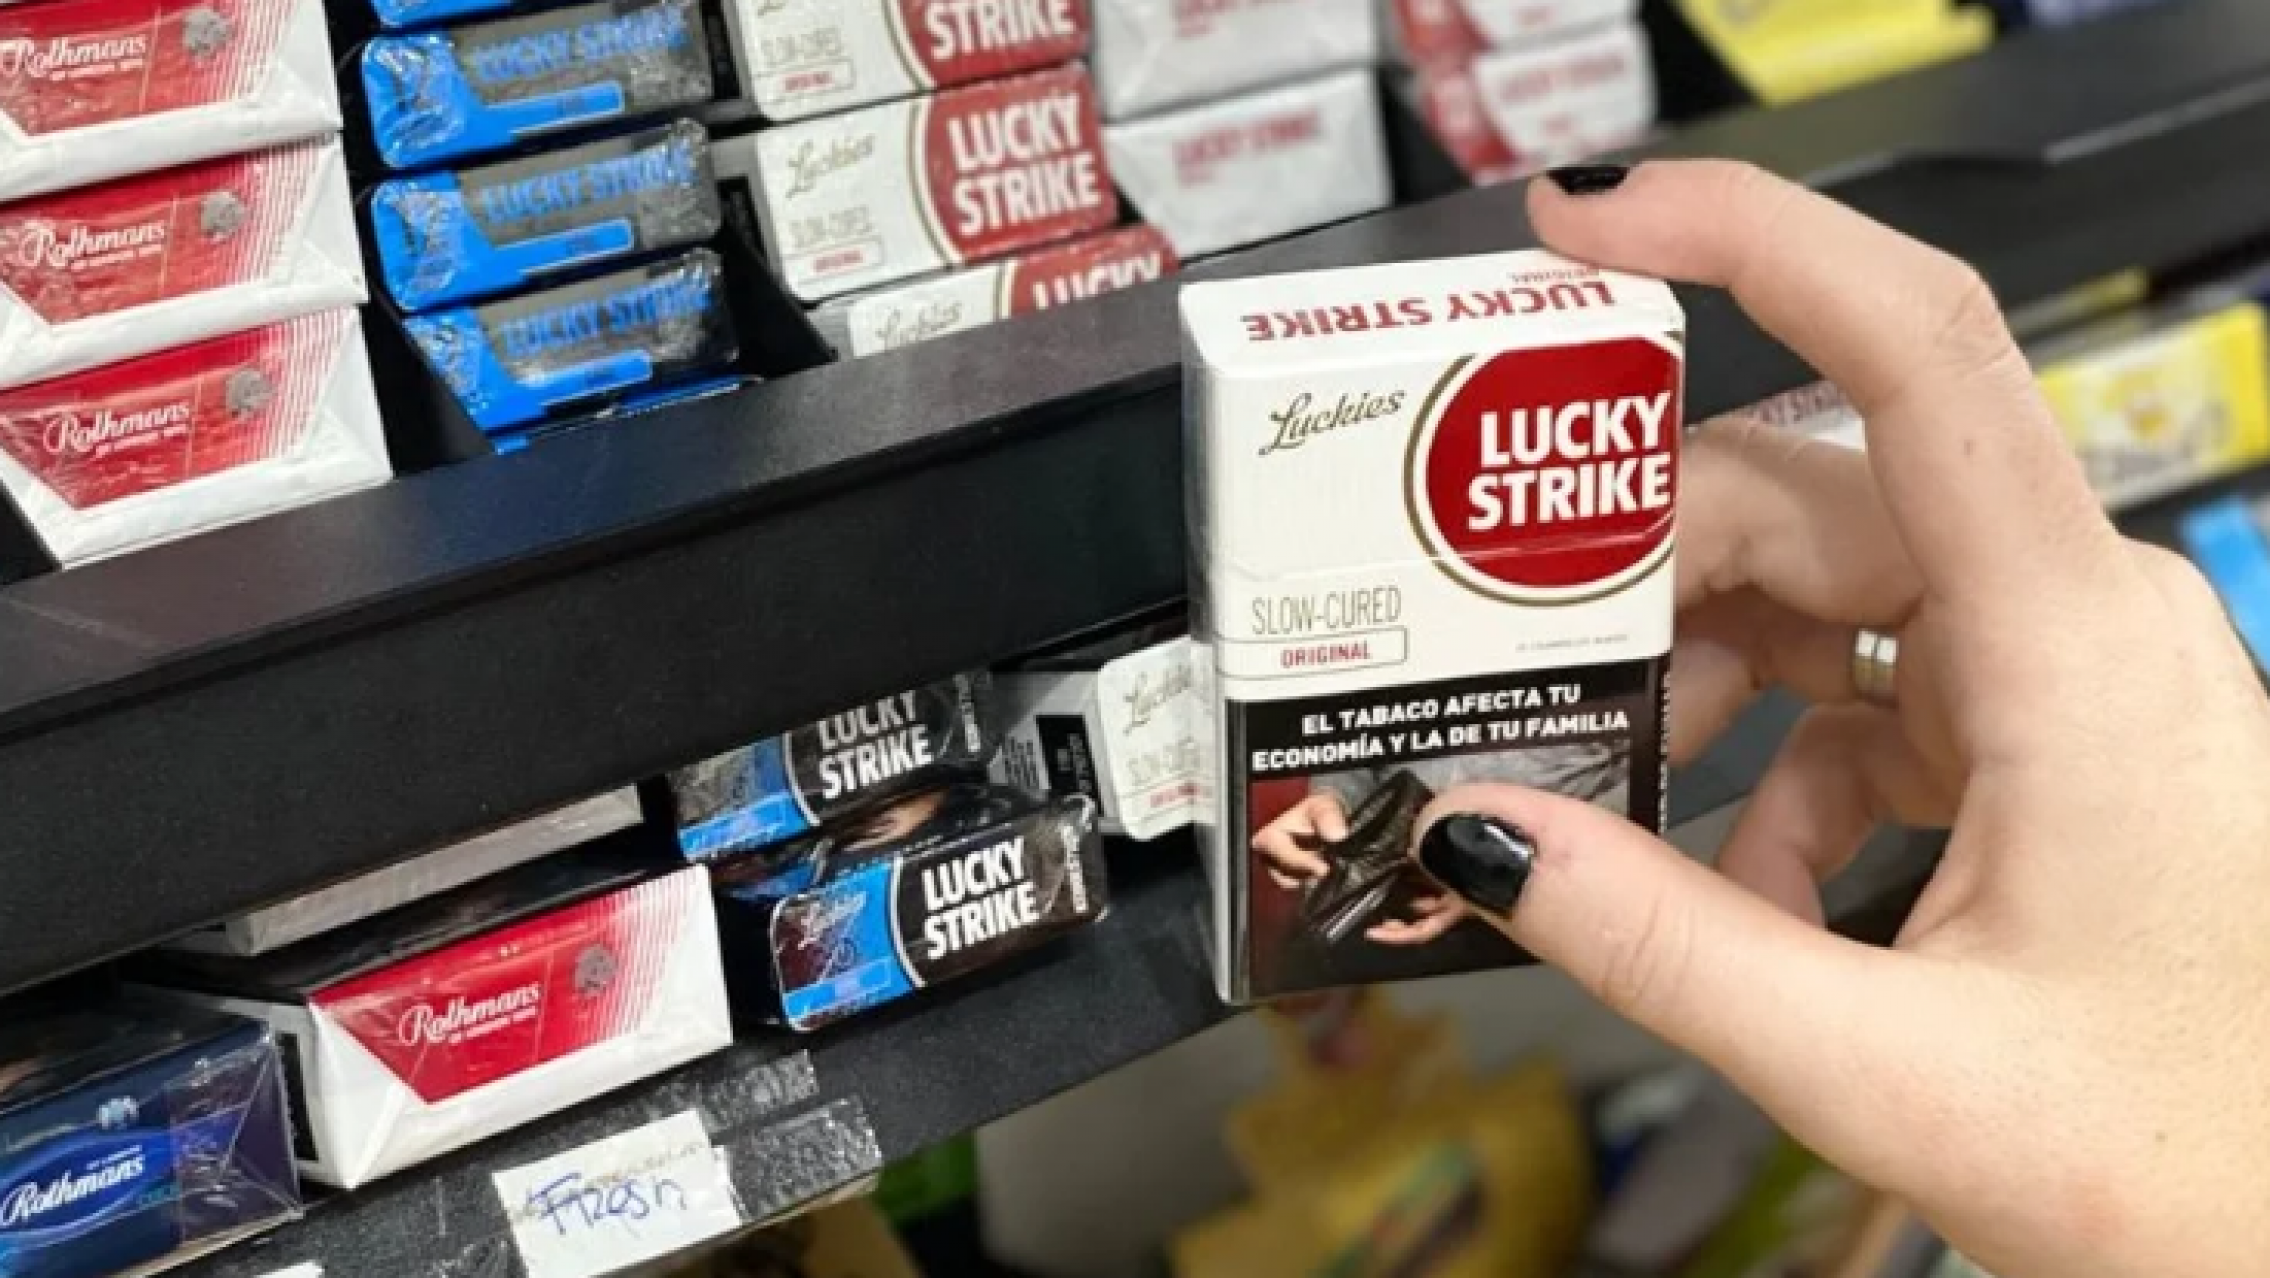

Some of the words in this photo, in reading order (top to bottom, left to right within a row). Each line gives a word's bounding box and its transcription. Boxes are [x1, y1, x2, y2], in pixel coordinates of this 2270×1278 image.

[1, 33, 147, 79] Rothmans
[922, 0, 1077, 61] STRIKE
[946, 92, 1083, 173] LUCKY
[950, 152, 1102, 239] STRIKE
[18, 219, 166, 267] Rothmans
[1239, 298, 1434, 342] STRIKE
[1447, 281, 1618, 324] LUCKY
[42, 401, 191, 454] Rothmans
[1258, 391, 1406, 456] Luckies
[1480, 391, 1671, 469] LUCKY
[1467, 452, 1672, 532] STRIKE
[1251, 587, 1401, 635] SLOW-CURED
[1281, 640, 1371, 669] ORIGINAL
[817, 689, 919, 750] LUCKY
[1301, 713, 1335, 736] EL
[1338, 698, 1440, 732] TABACO
[1443, 687, 1544, 718] AFECTA
[1548, 683, 1582, 705] TU
[817, 724, 934, 800] STRIKE
[1252, 731, 1384, 771] ECONOMÍA
[1387, 732, 1406, 754] Y
[1410, 730, 1443, 751] LA
[1449, 724, 1482, 747] DE
[1486, 719, 1520, 742] TU
[1525, 710, 1631, 738] FAMILIA
[919, 836, 1026, 912] LUCKY
[922, 880, 1041, 960] STRIKE
[399, 980, 541, 1047] Rothmans
[0, 1152, 146, 1228] Rothmans
